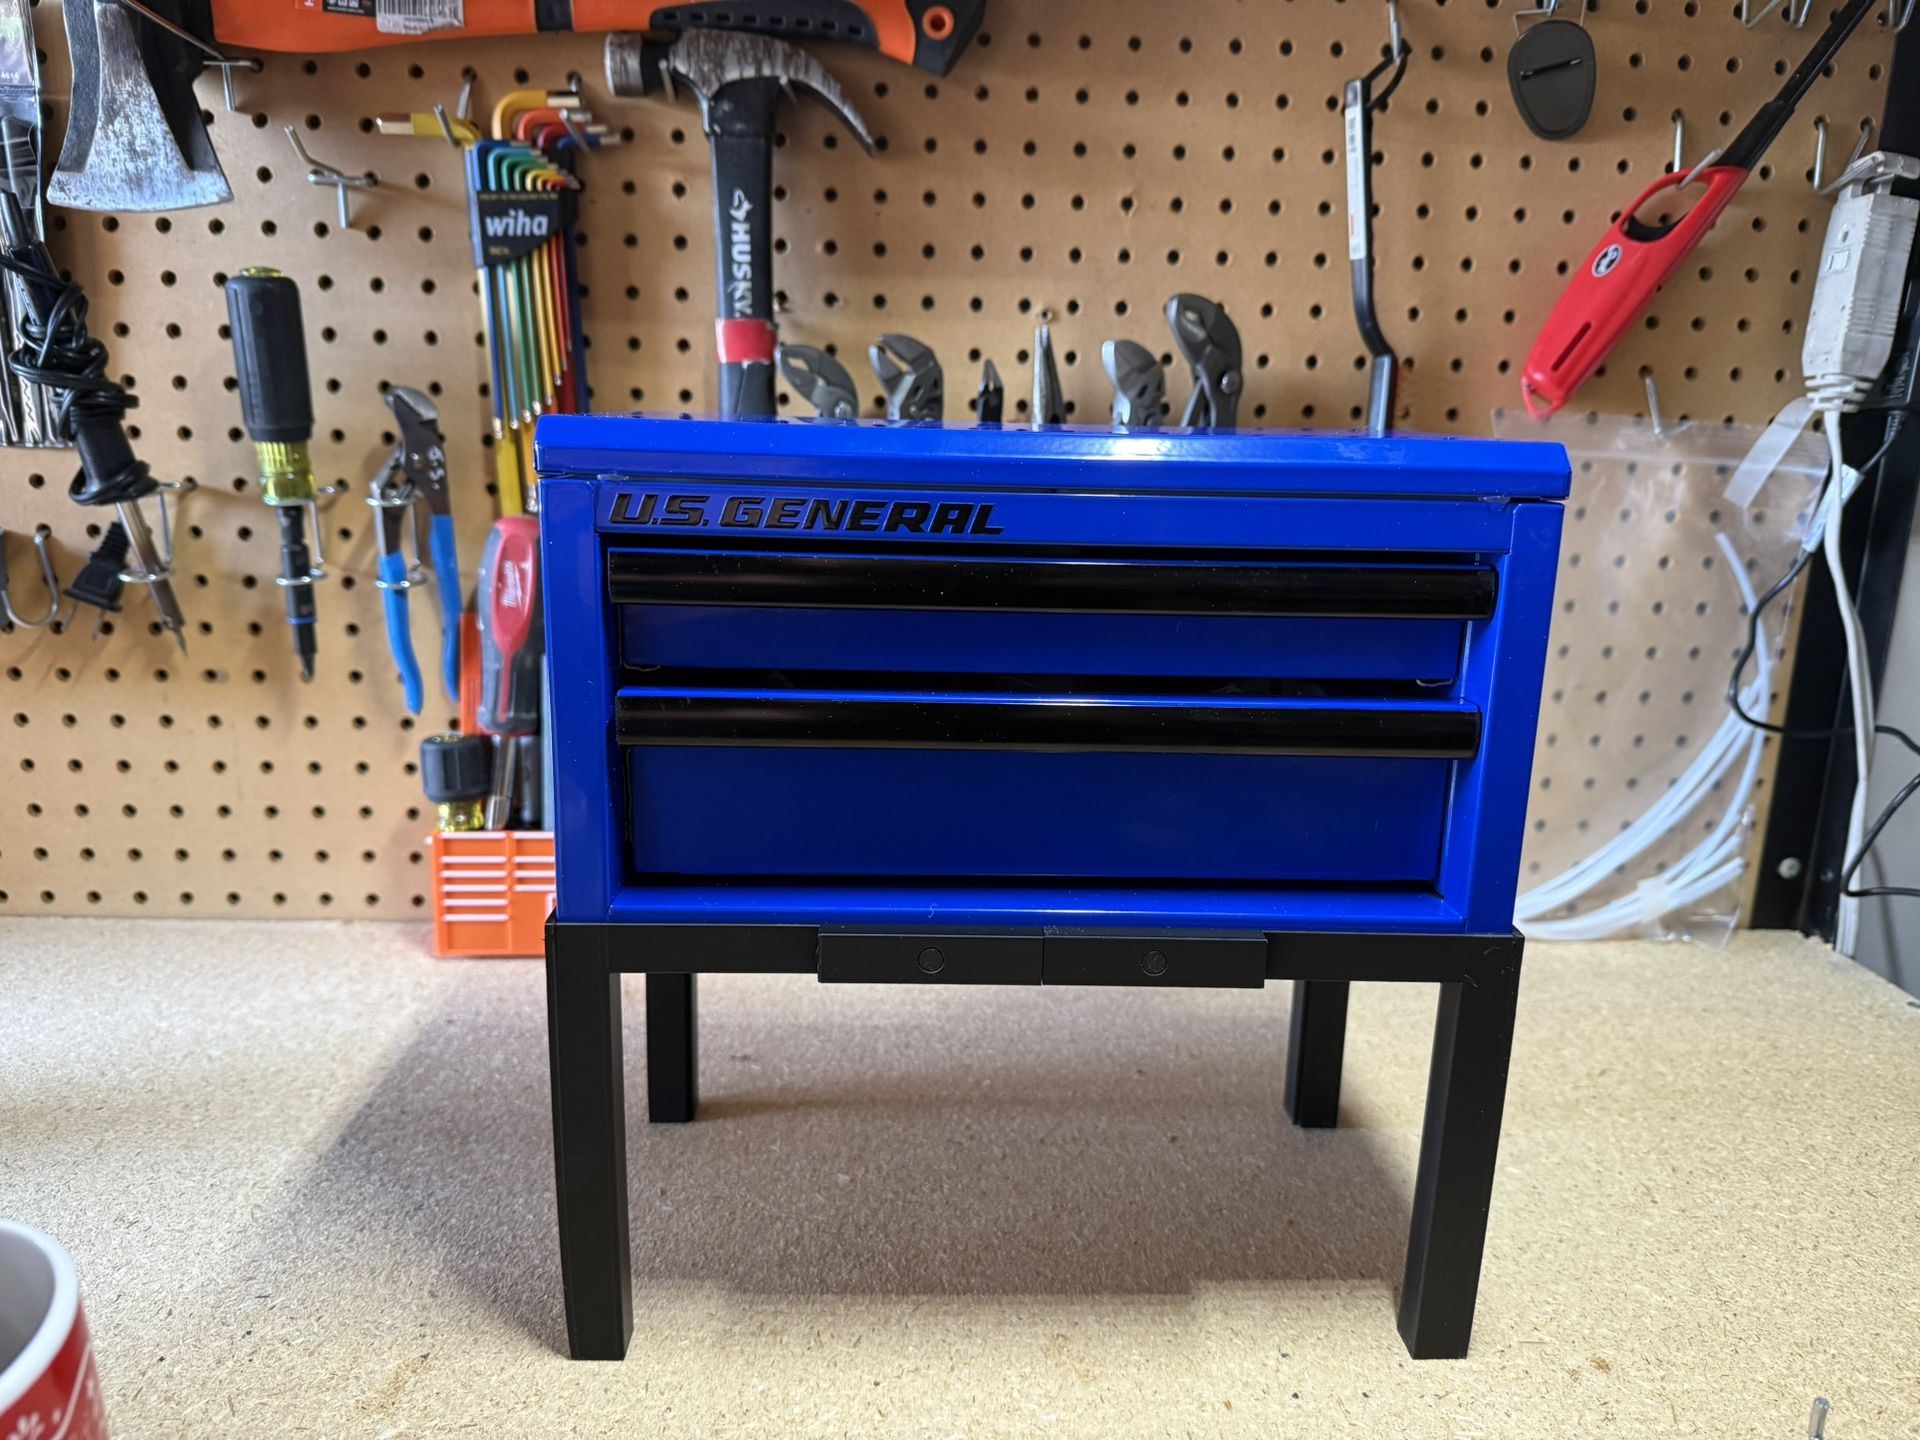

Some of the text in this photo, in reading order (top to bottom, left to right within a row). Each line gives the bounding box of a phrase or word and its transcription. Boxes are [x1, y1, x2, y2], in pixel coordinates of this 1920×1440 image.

[485, 208, 549, 237] wiha
[730, 221, 753, 316] HUSKY
[608, 492, 1005, 535] U.S. GENERAL
